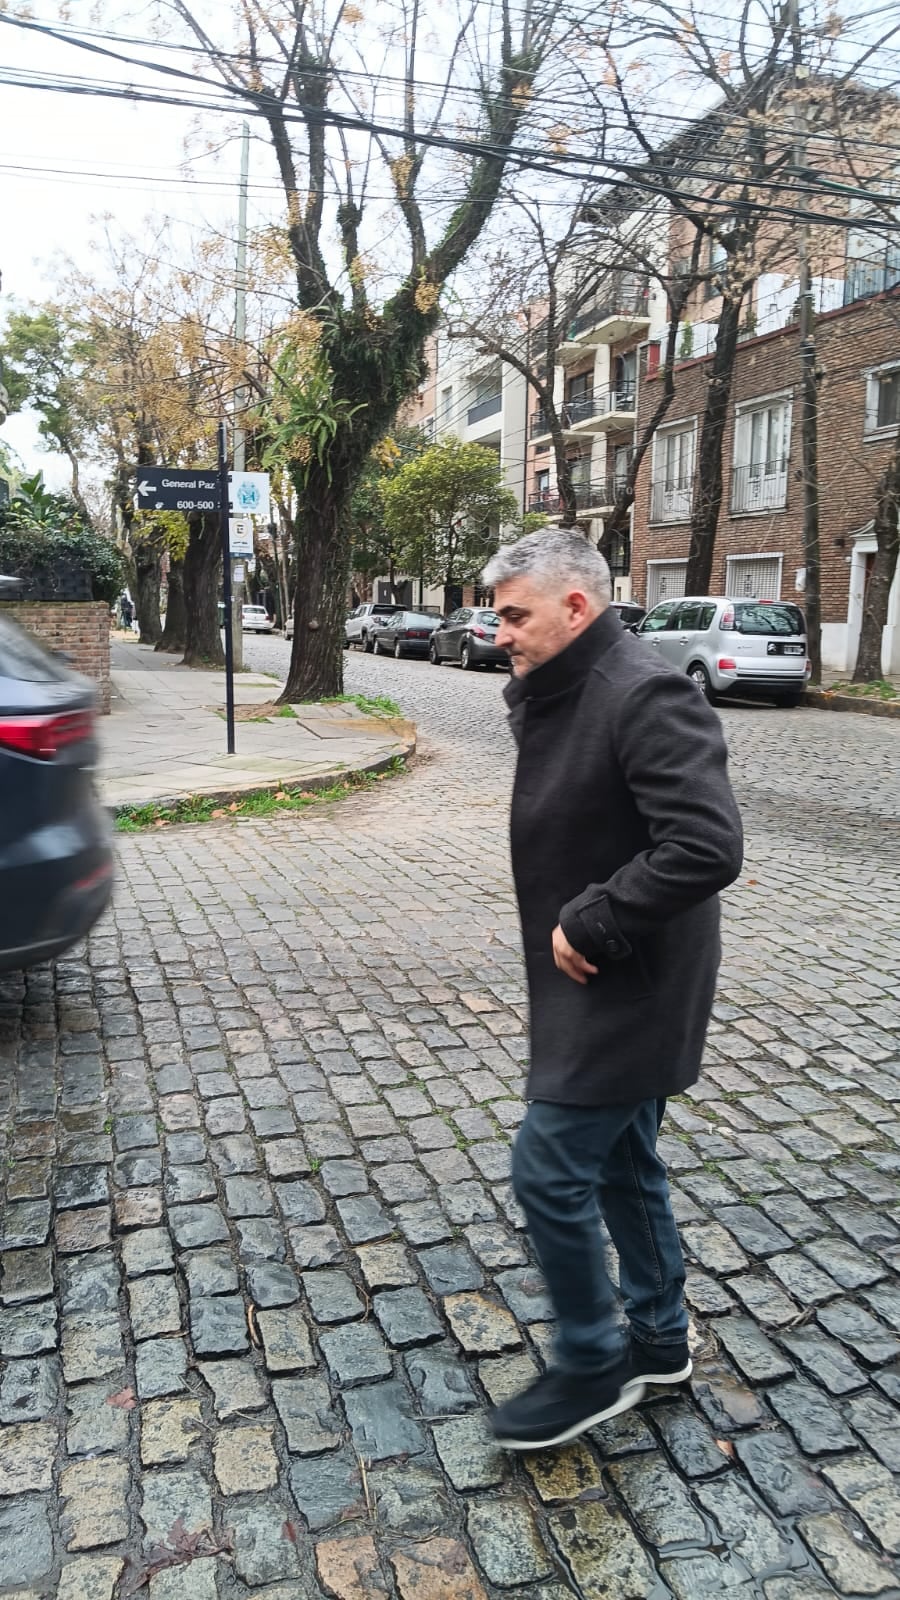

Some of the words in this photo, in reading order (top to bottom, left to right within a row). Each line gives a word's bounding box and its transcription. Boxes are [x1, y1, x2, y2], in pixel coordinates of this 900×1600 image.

[161, 479, 196, 488] General
[198, 480, 215, 489] Paz
[177, 501, 214, 509] 600-500
